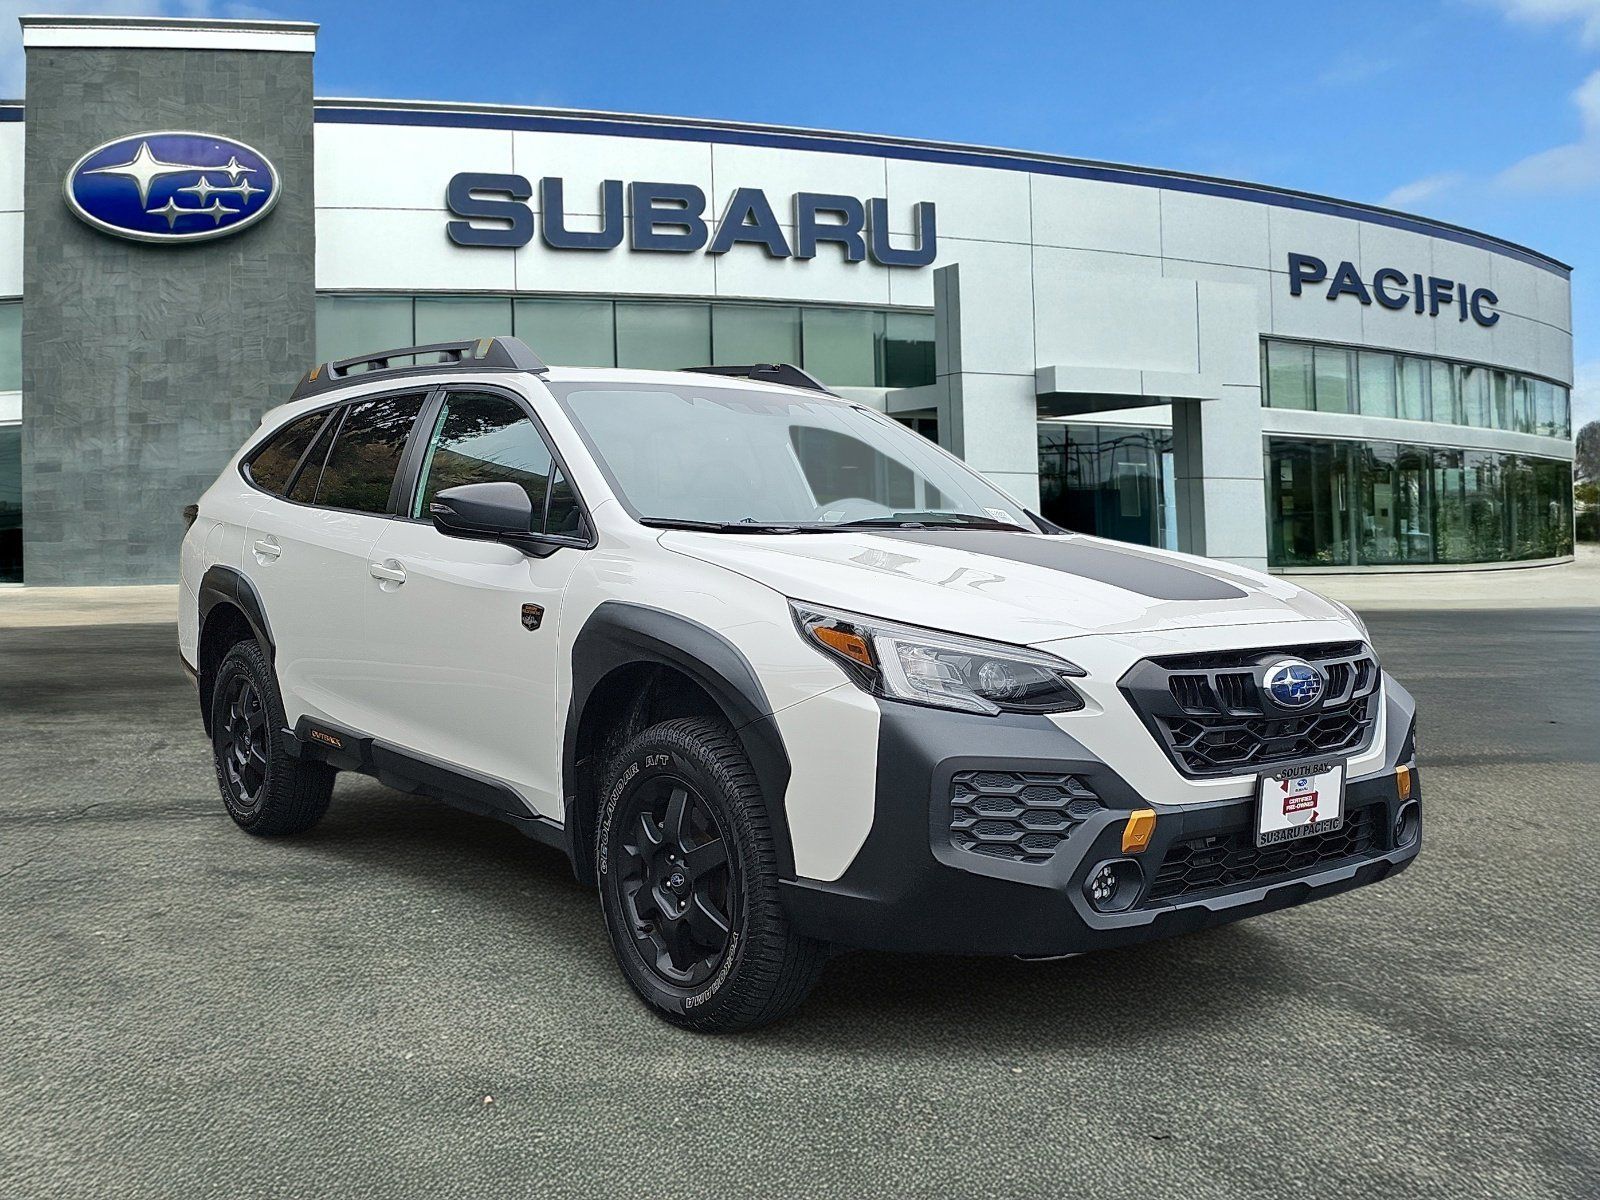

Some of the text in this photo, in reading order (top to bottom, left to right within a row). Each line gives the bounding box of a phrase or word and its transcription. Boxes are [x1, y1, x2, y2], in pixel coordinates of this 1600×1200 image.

[447, 172, 937, 268] SUBARU
[1288, 252, 1500, 327] PACIFIC
[311, 730, 342, 747] OUTBACK
[1281, 762, 1328, 778] SOUTH BAY
[600, 754, 669, 875] GEOLANDAR A/T
[1289, 795, 1312, 804] CERTIFIED
[1260, 820, 1339, 845] SUBARU PACIFIC
[686, 931, 739, 1009] YOKOHAMA
